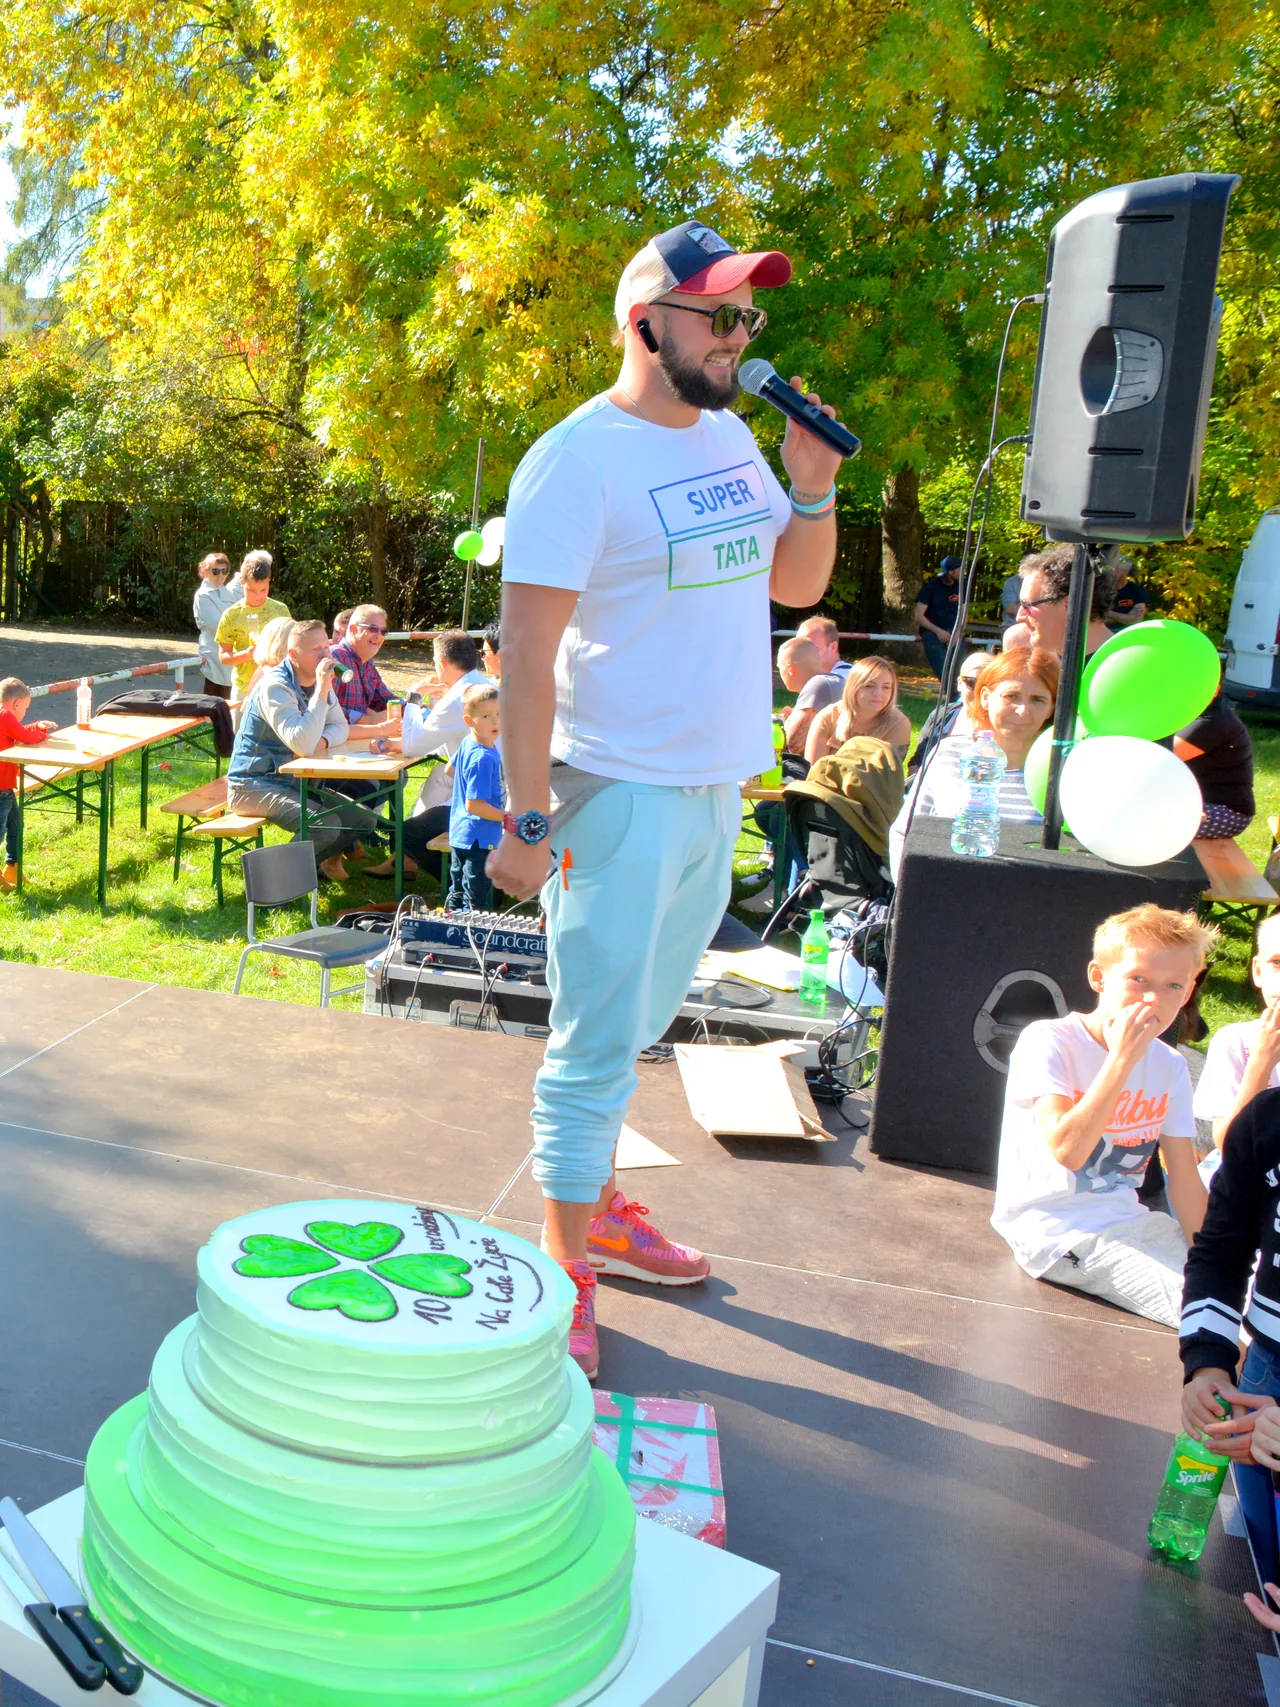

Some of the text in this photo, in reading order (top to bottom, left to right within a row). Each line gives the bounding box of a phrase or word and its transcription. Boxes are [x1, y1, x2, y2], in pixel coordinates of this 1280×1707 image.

[687, 478, 755, 515] SUPER
[713, 535, 760, 570] TATA
[1073, 1089, 1169, 1125] libu
[413, 1298, 452, 1325] 10
[476, 1309, 512, 1330] Na
[1176, 1471, 1215, 1485] Sprite
